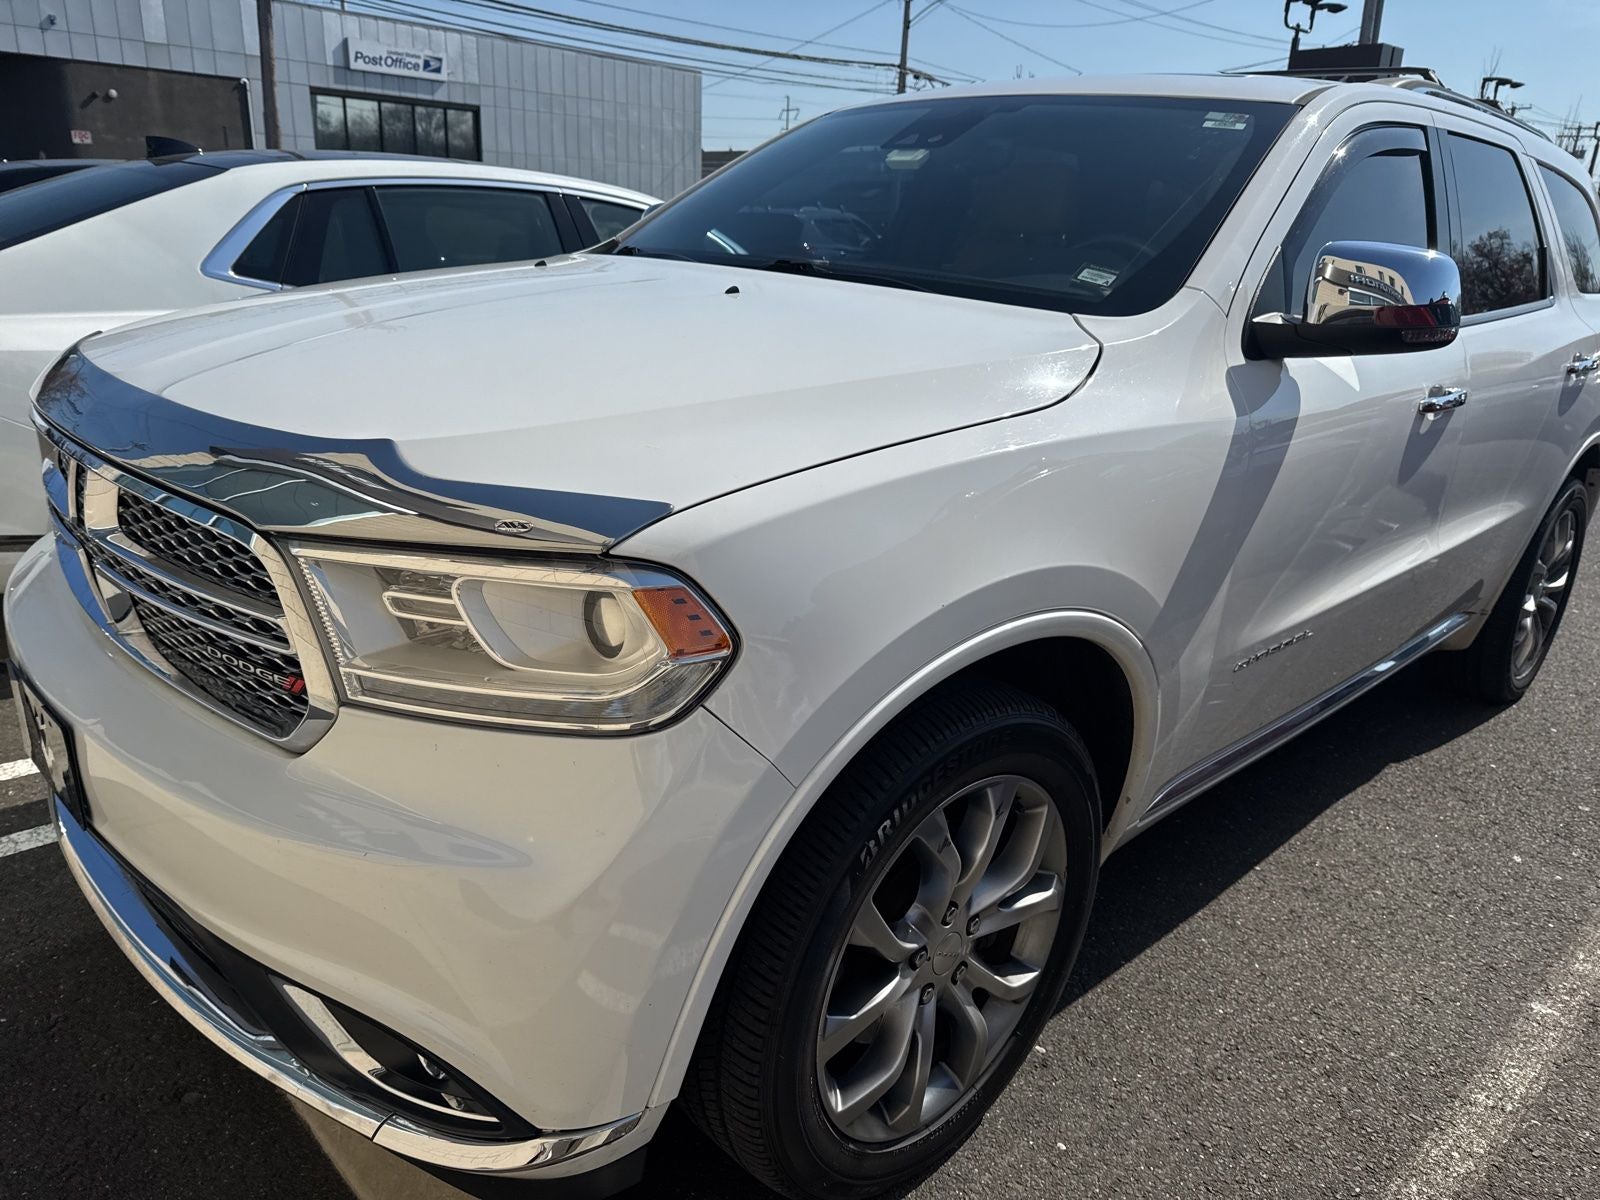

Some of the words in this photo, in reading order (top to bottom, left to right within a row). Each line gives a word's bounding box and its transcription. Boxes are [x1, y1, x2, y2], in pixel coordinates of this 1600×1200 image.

[354, 51, 383, 67] Post
[384, 55, 420, 72] Office
[207, 645, 292, 689] DODGE
